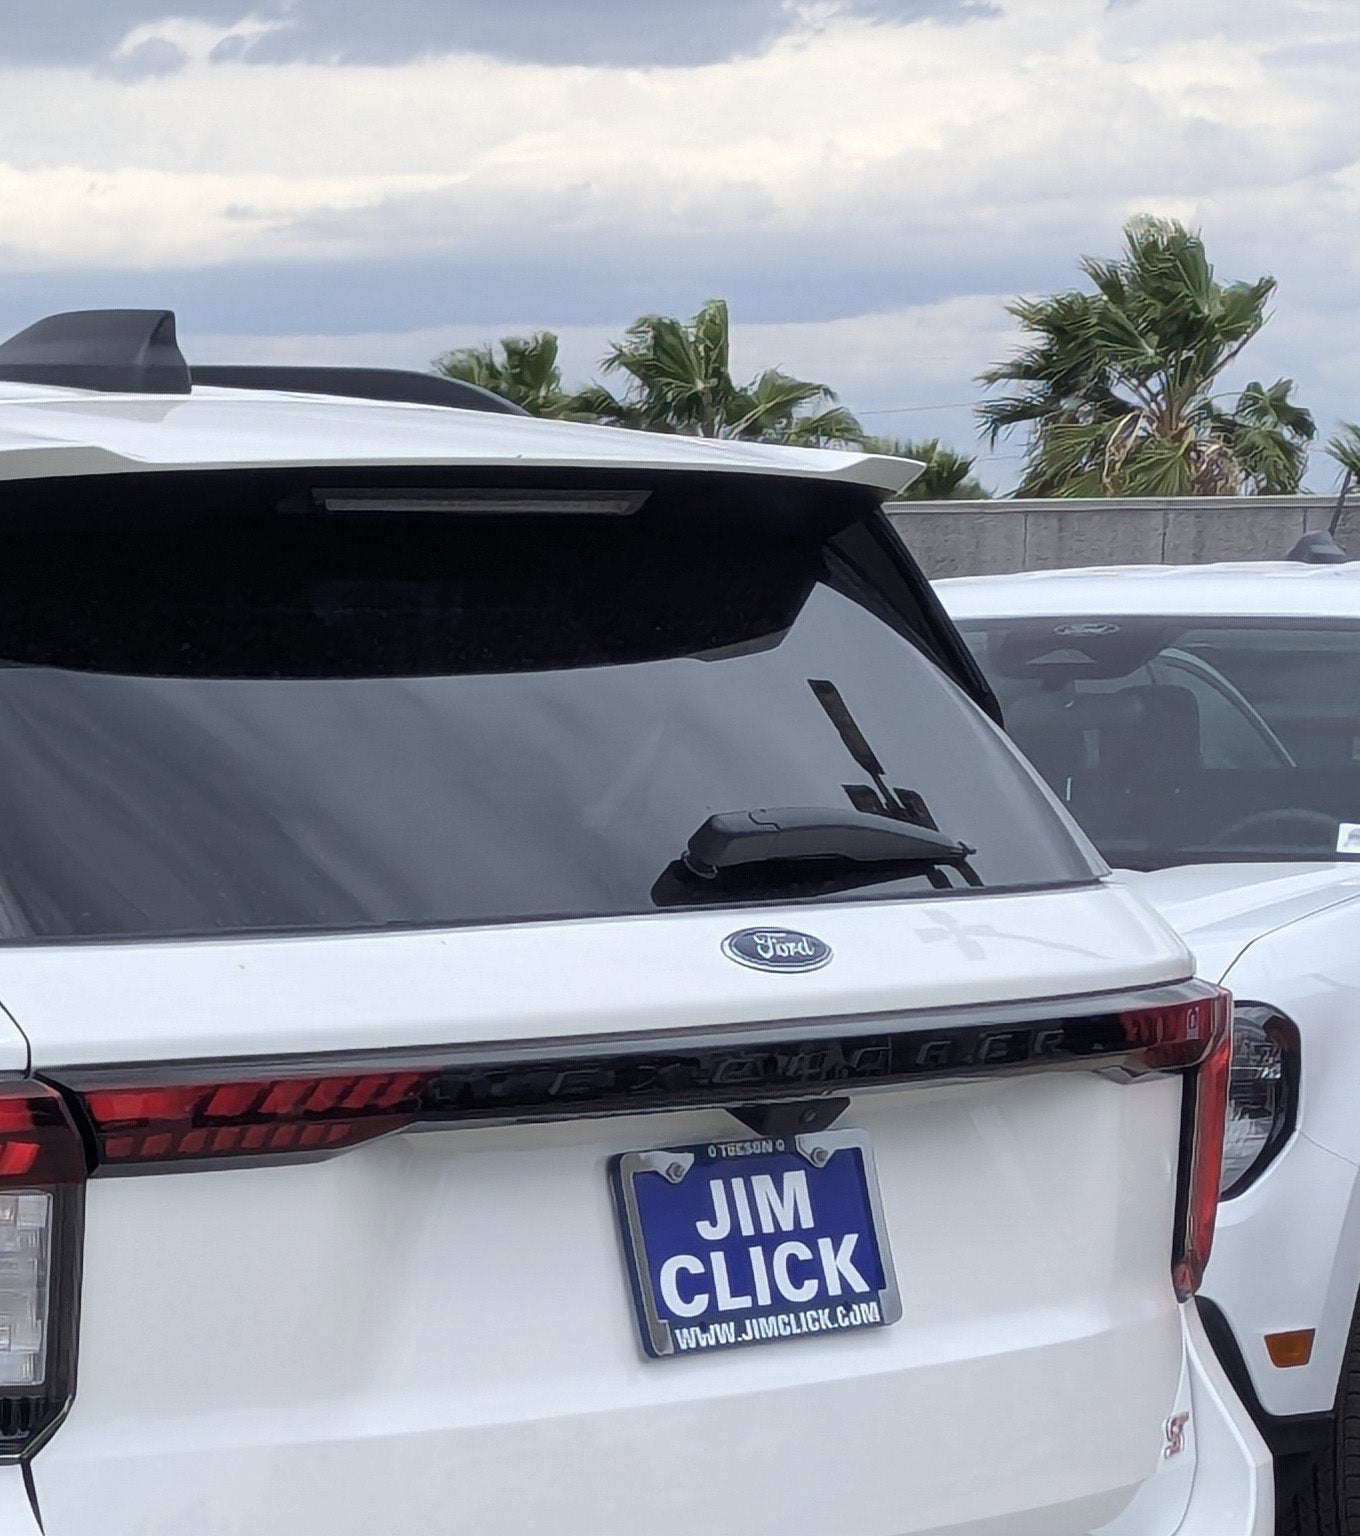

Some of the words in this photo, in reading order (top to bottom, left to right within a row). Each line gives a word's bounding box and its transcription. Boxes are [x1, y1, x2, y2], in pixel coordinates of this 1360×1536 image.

[753, 932, 815, 959] Ford
[695, 1170, 815, 1240] JIM
[659, 1233, 871, 1318] CLICK
[674, 1301, 881, 1350] WWW.JIMCLICK.COM
